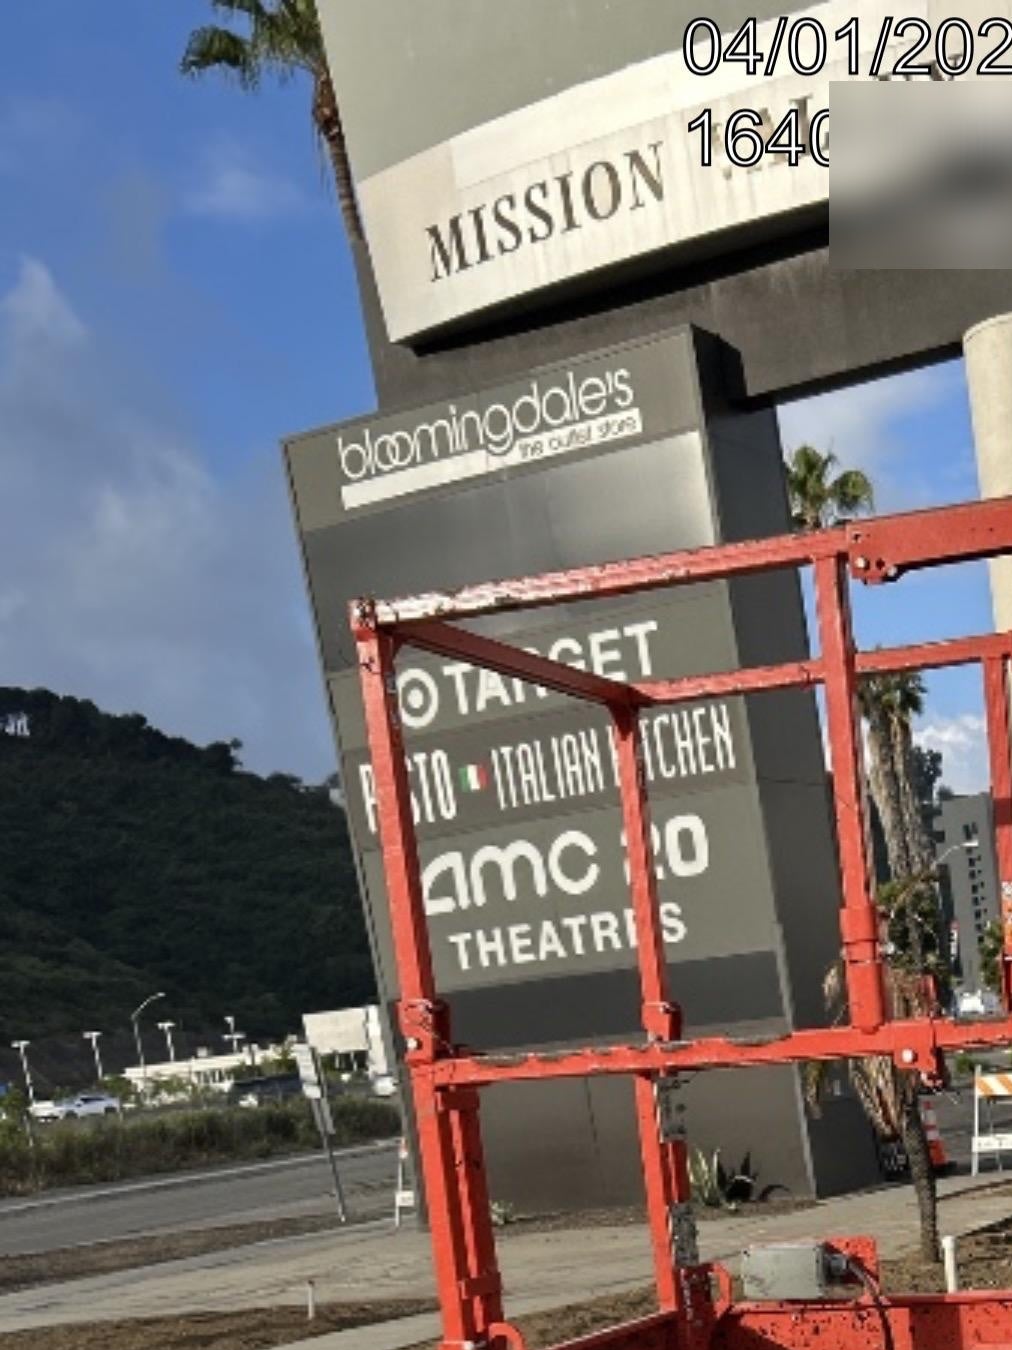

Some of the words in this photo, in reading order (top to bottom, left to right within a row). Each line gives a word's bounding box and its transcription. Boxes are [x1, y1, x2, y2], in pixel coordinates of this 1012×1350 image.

[425, 140, 665, 283] MISSION
[338, 368, 634, 480] bloomingdale's
[491, 727, 605, 810] ITALIAN
[607, 704, 736, 788] TCHEN
